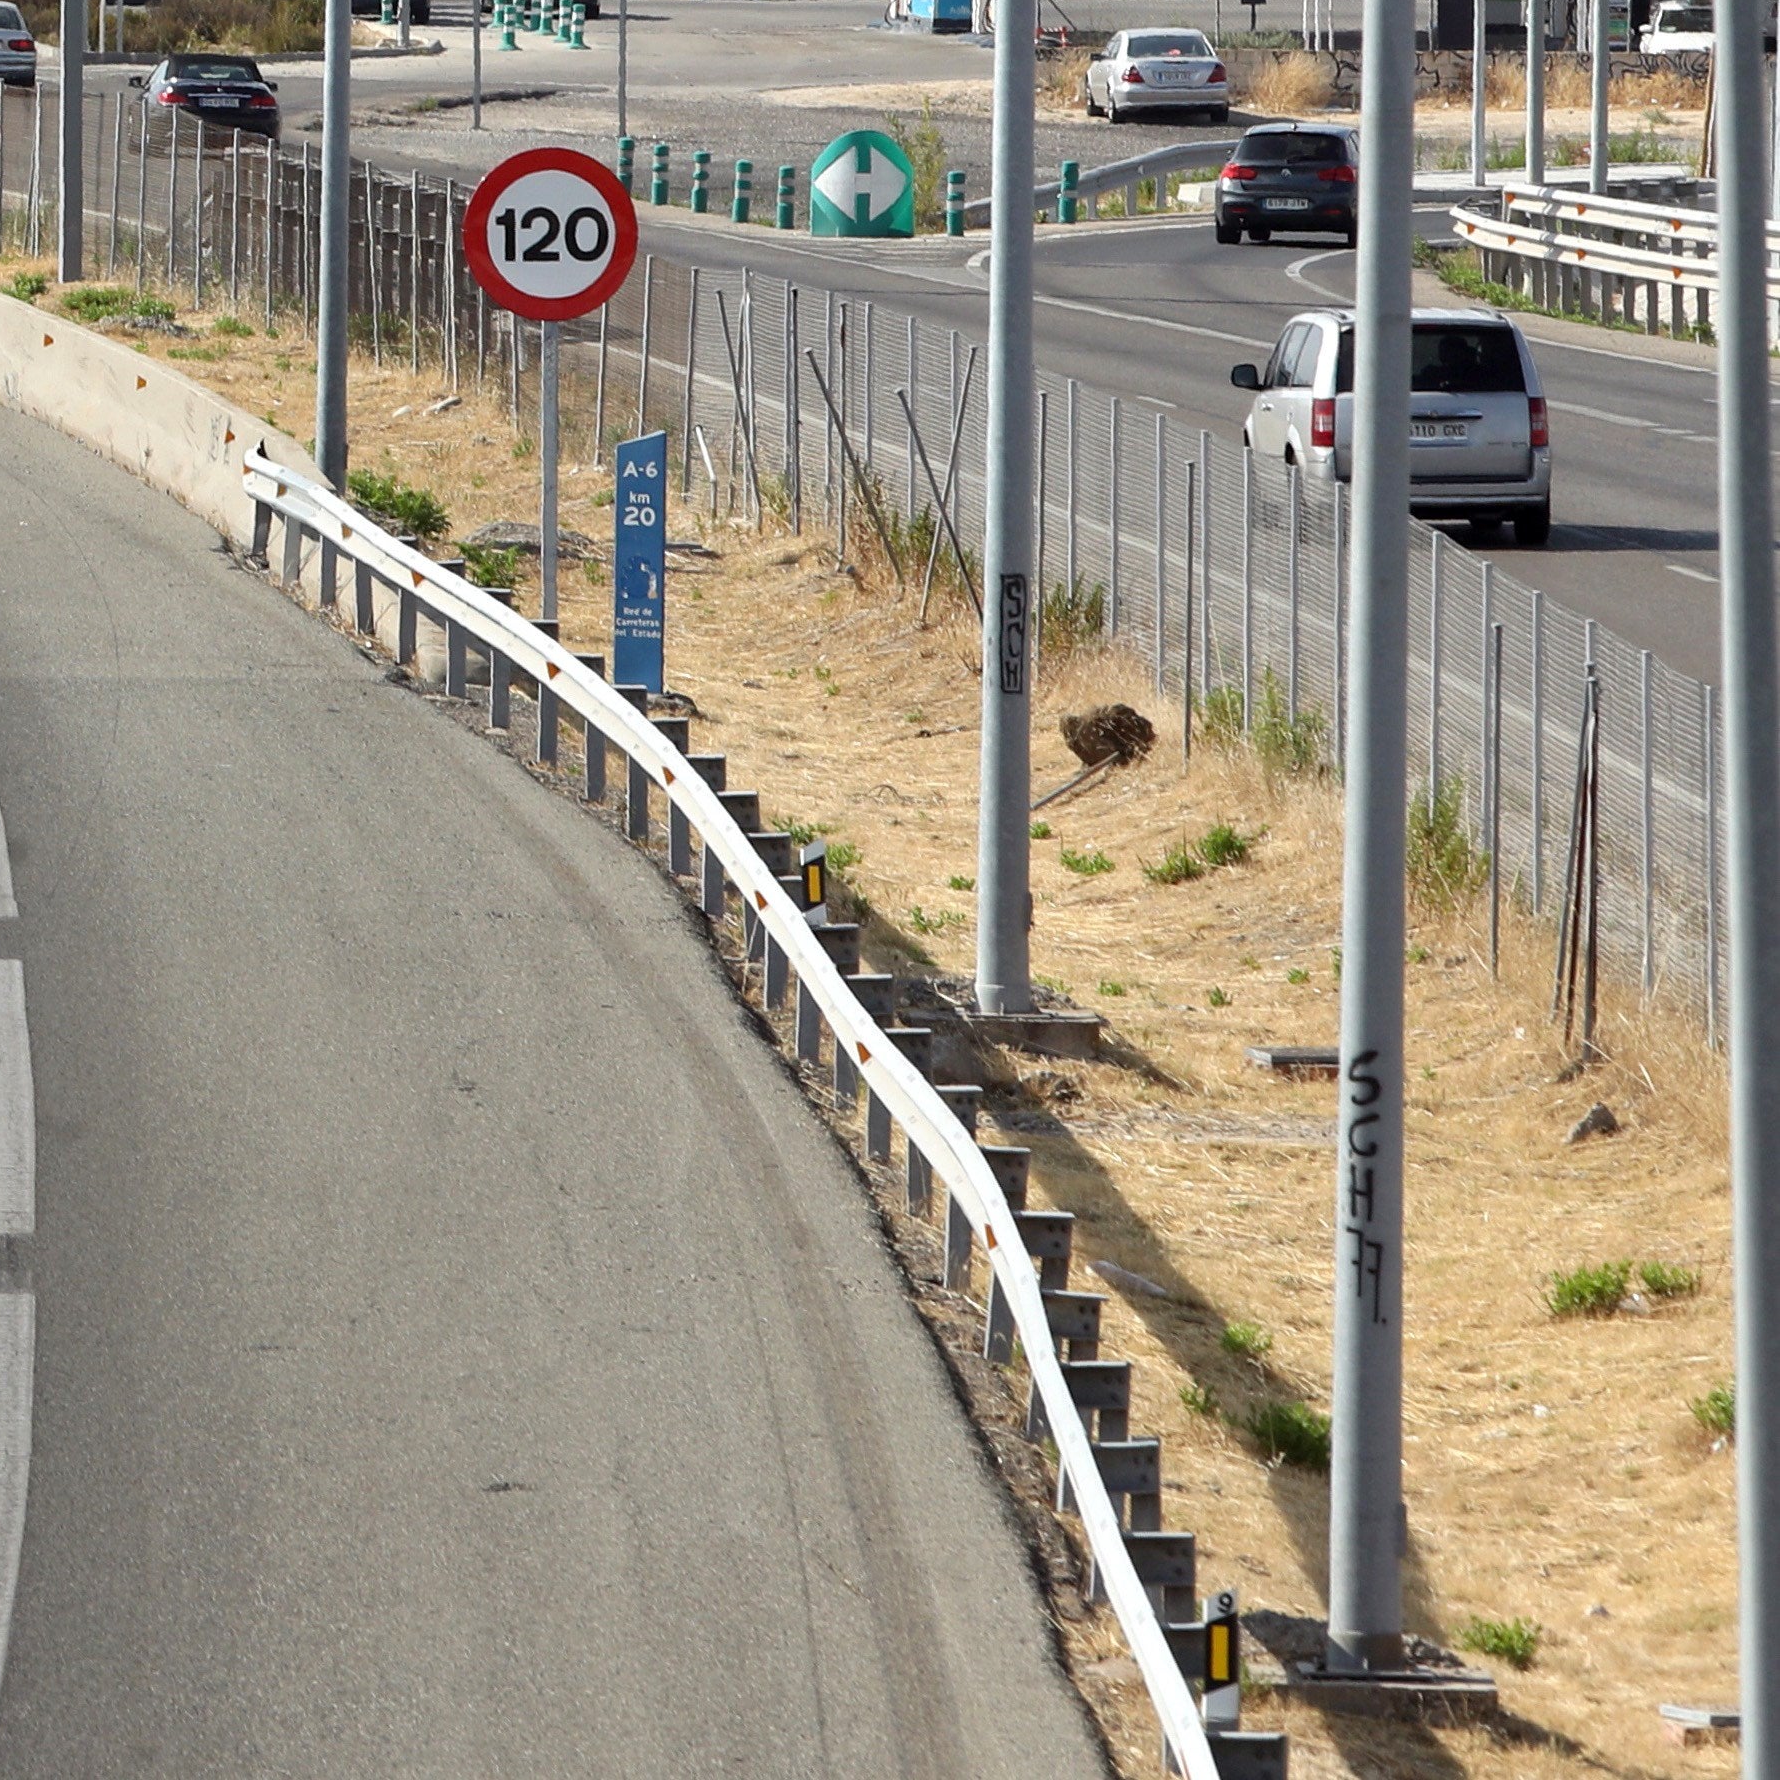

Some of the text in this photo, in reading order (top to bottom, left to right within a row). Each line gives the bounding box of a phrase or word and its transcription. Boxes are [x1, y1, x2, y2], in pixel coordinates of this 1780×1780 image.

[495, 206, 609, 262] 120
[623, 460, 658, 479] A-6
[629, 492, 651, 507] km
[623, 507, 656, 527] 20
